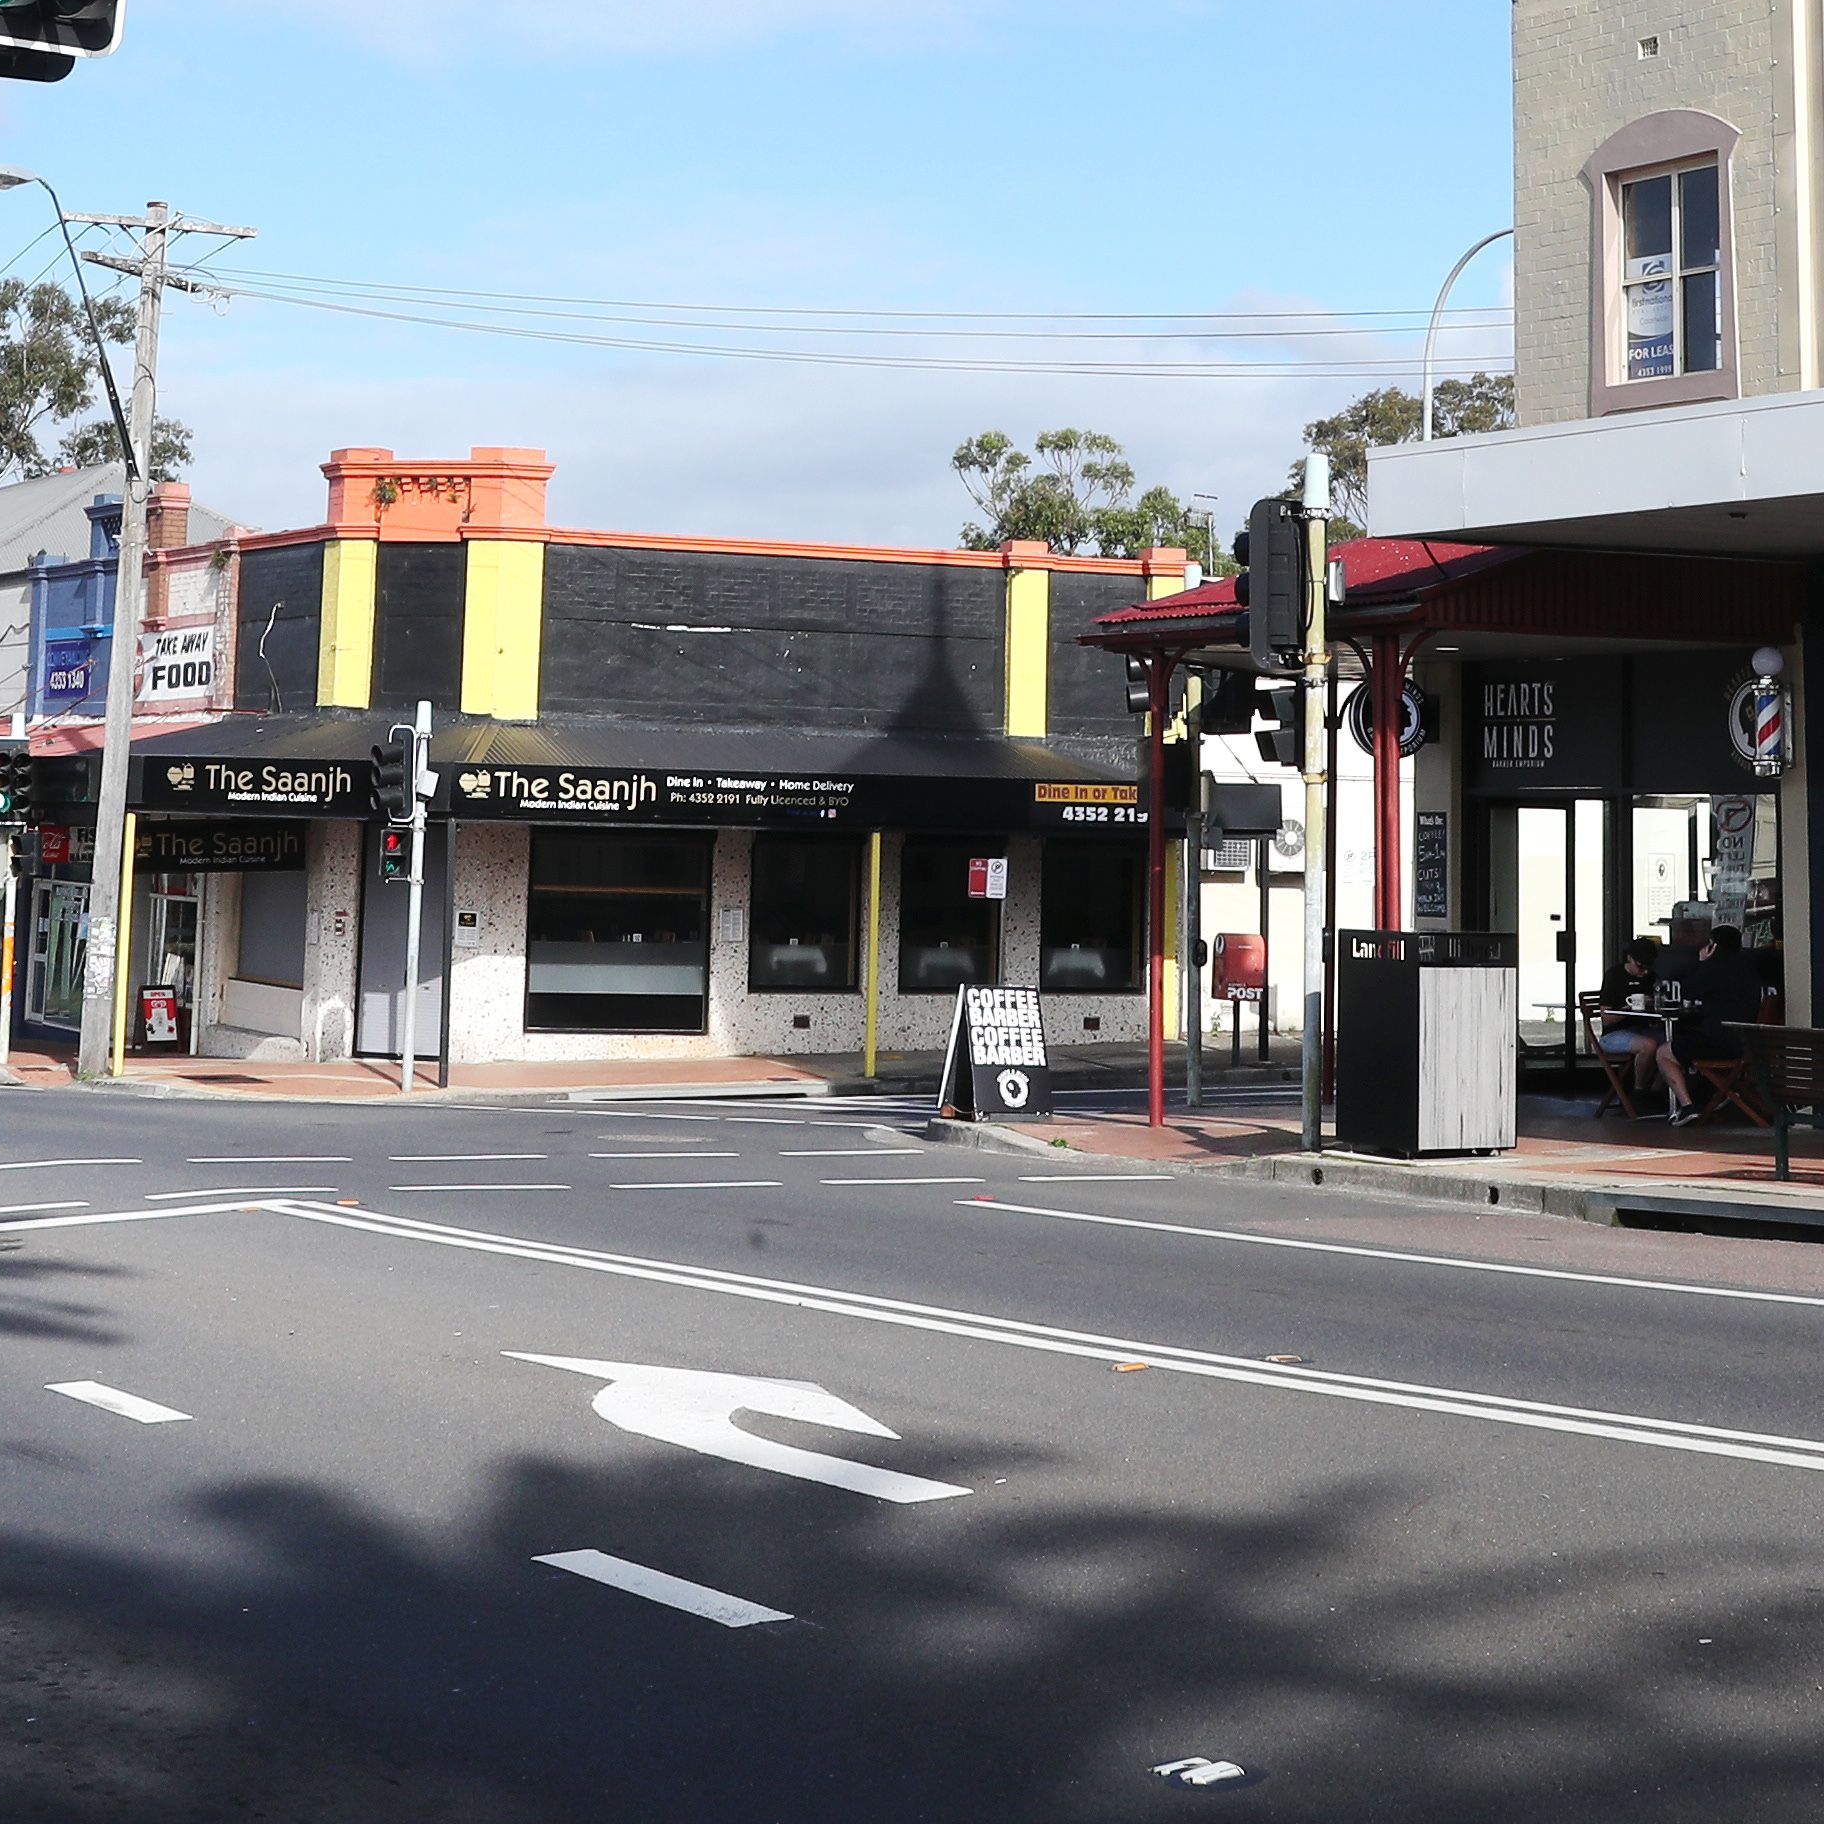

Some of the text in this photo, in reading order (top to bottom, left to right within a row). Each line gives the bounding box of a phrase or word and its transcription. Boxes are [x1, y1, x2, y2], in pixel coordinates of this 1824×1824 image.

[1629, 344, 1674, 361] FOR LEAS
[156, 636, 178, 658] TAKE
[151, 660, 212, 691] FOOD
[1484, 682, 1554, 718] HEARTS
[1483, 725, 1554, 759] MINDS
[205, 764, 352, 803] The Saanjh
[494, 770, 658, 812] The Saanjh
[666, 776, 855, 794] Dine In Takeaway Home Delivery
[1037, 784, 1071, 800] Dine
[1075, 785, 1089, 800] In
[1092, 787, 1109, 800] or
[227, 791, 318, 804] Modern Indian Cuisine
[519, 798, 621, 812] Modern Indian Cuisine
[670, 792, 687, 804] Ph:
[688, 792, 715, 805] 4352
[716, 793, 741, 805] 2191
[745, 794, 770, 807] Fully
[828, 796, 850, 807] BYO
[1061, 806, 1109, 822] 4352
[155, 831, 299, 862] The Saanjh
[967, 988, 1040, 1010] COFFEE
[1227, 987, 1263, 1000] POST
[969, 1007, 1042, 1028] BARBER
[971, 1026, 1045, 1048] COFFEE
[973, 1045, 1047, 1067] BARBER
